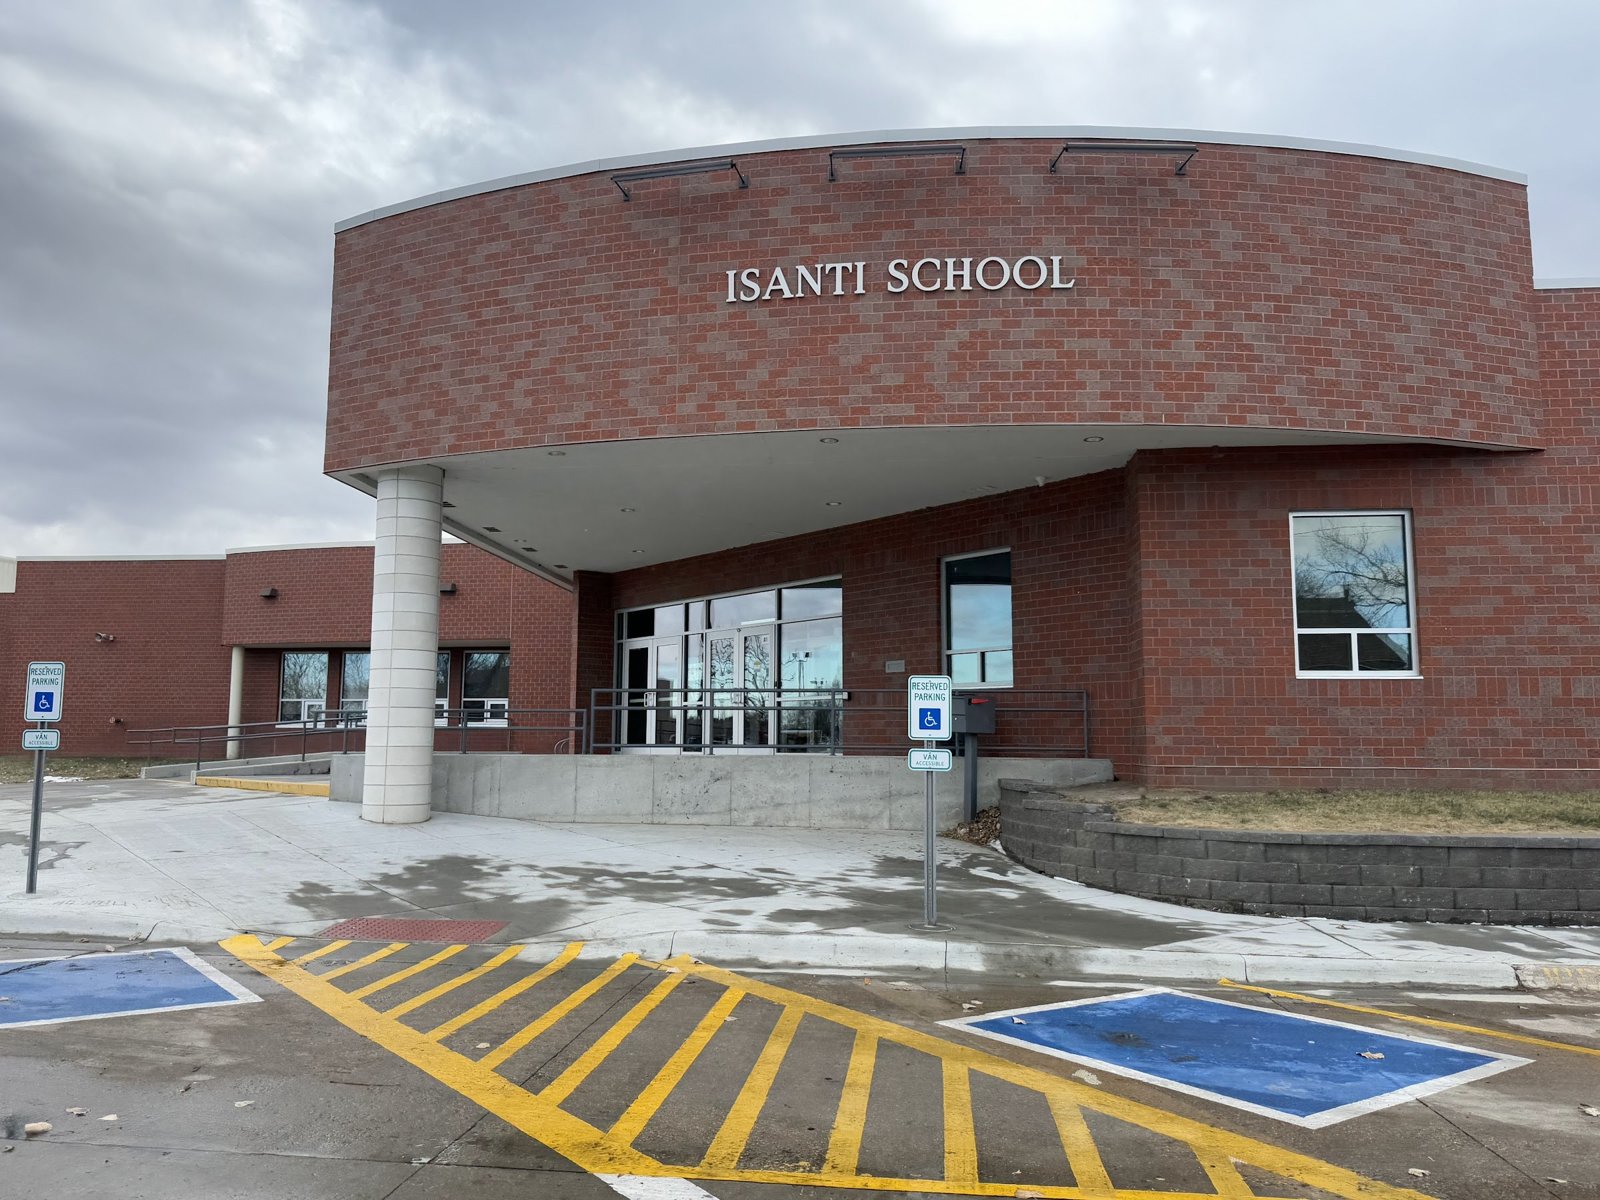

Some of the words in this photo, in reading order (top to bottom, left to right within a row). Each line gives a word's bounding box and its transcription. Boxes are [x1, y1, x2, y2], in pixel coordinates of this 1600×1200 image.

[725, 261, 866, 303] ISANTI
[886, 255, 1076, 293] SCHOOL
[31, 668, 61, 676] RESERVED
[32, 678, 59, 686] PARKING
[911, 682, 948, 690] RESERVED
[914, 693, 946, 701] PARKING
